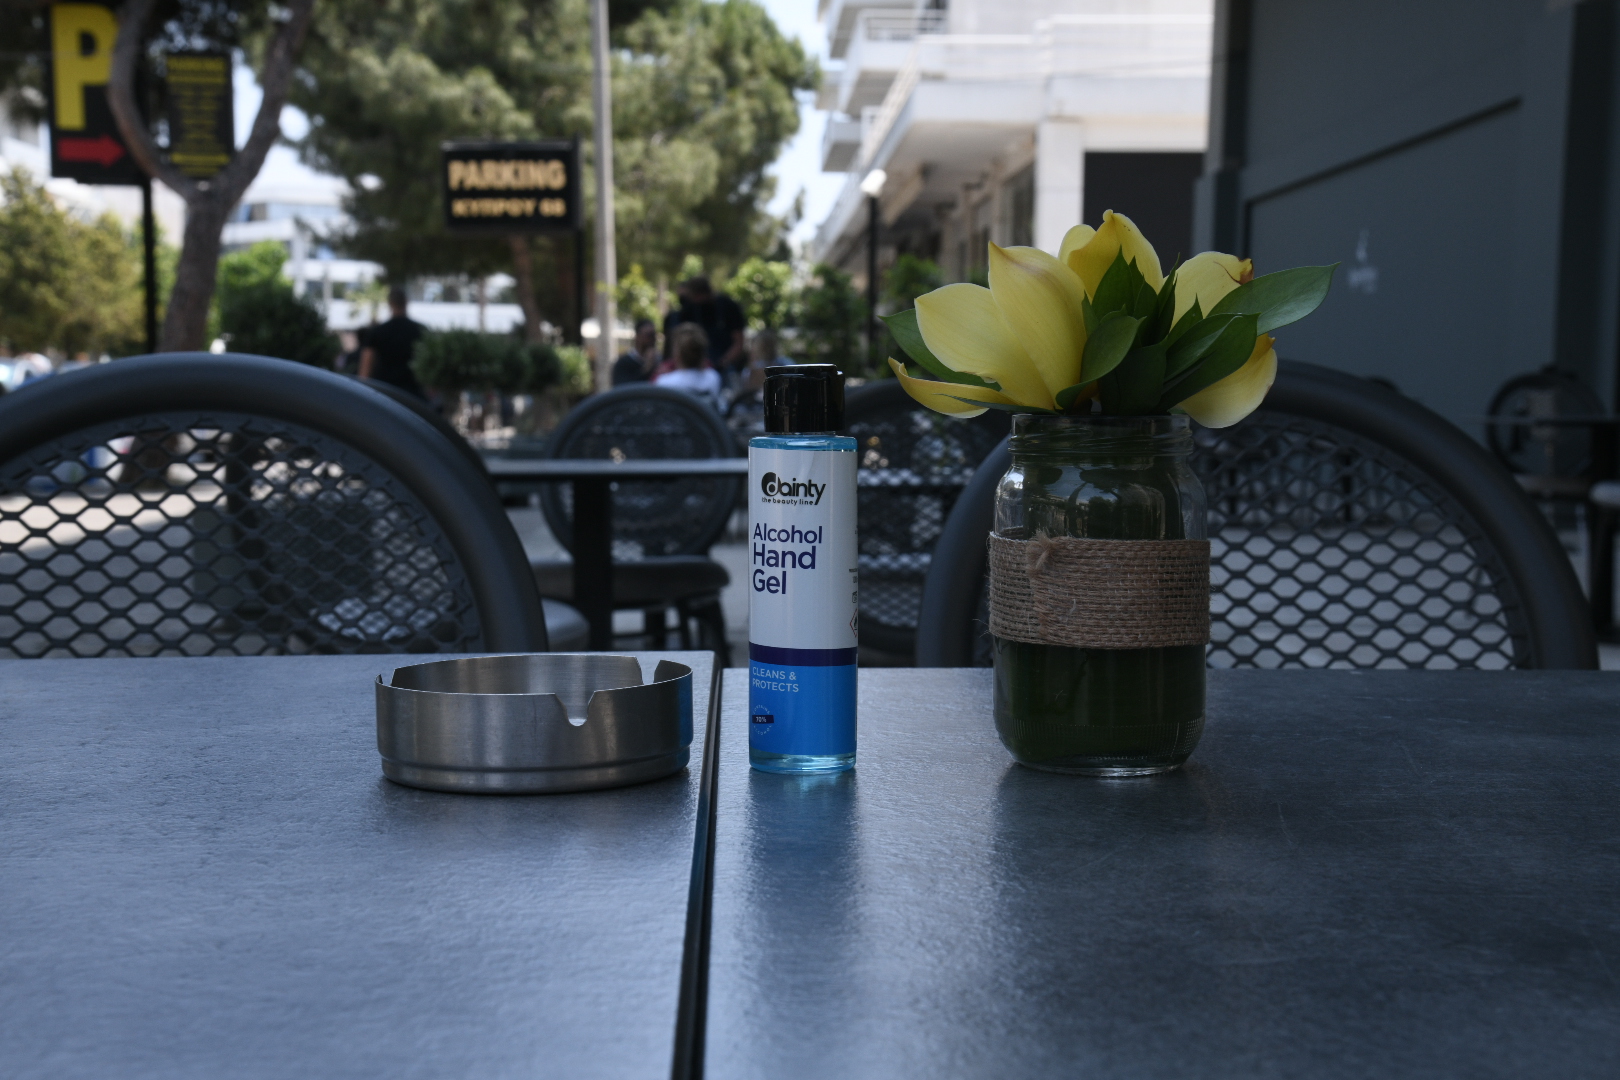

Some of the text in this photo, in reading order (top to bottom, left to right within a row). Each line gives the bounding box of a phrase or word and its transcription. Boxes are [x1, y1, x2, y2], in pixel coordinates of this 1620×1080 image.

[52, 3, 119, 129] P
[448, 159, 567, 190] PARKING
[761, 471, 826, 506] dainty
[772, 497, 798, 506] beauty
[753, 522, 823, 544] Alcohol
[753, 541, 817, 570] Hand
[752, 568, 787, 595] Gel
[752, 666, 797, 681] CLEANS &
[752, 677, 800, 693] PROTECTS
